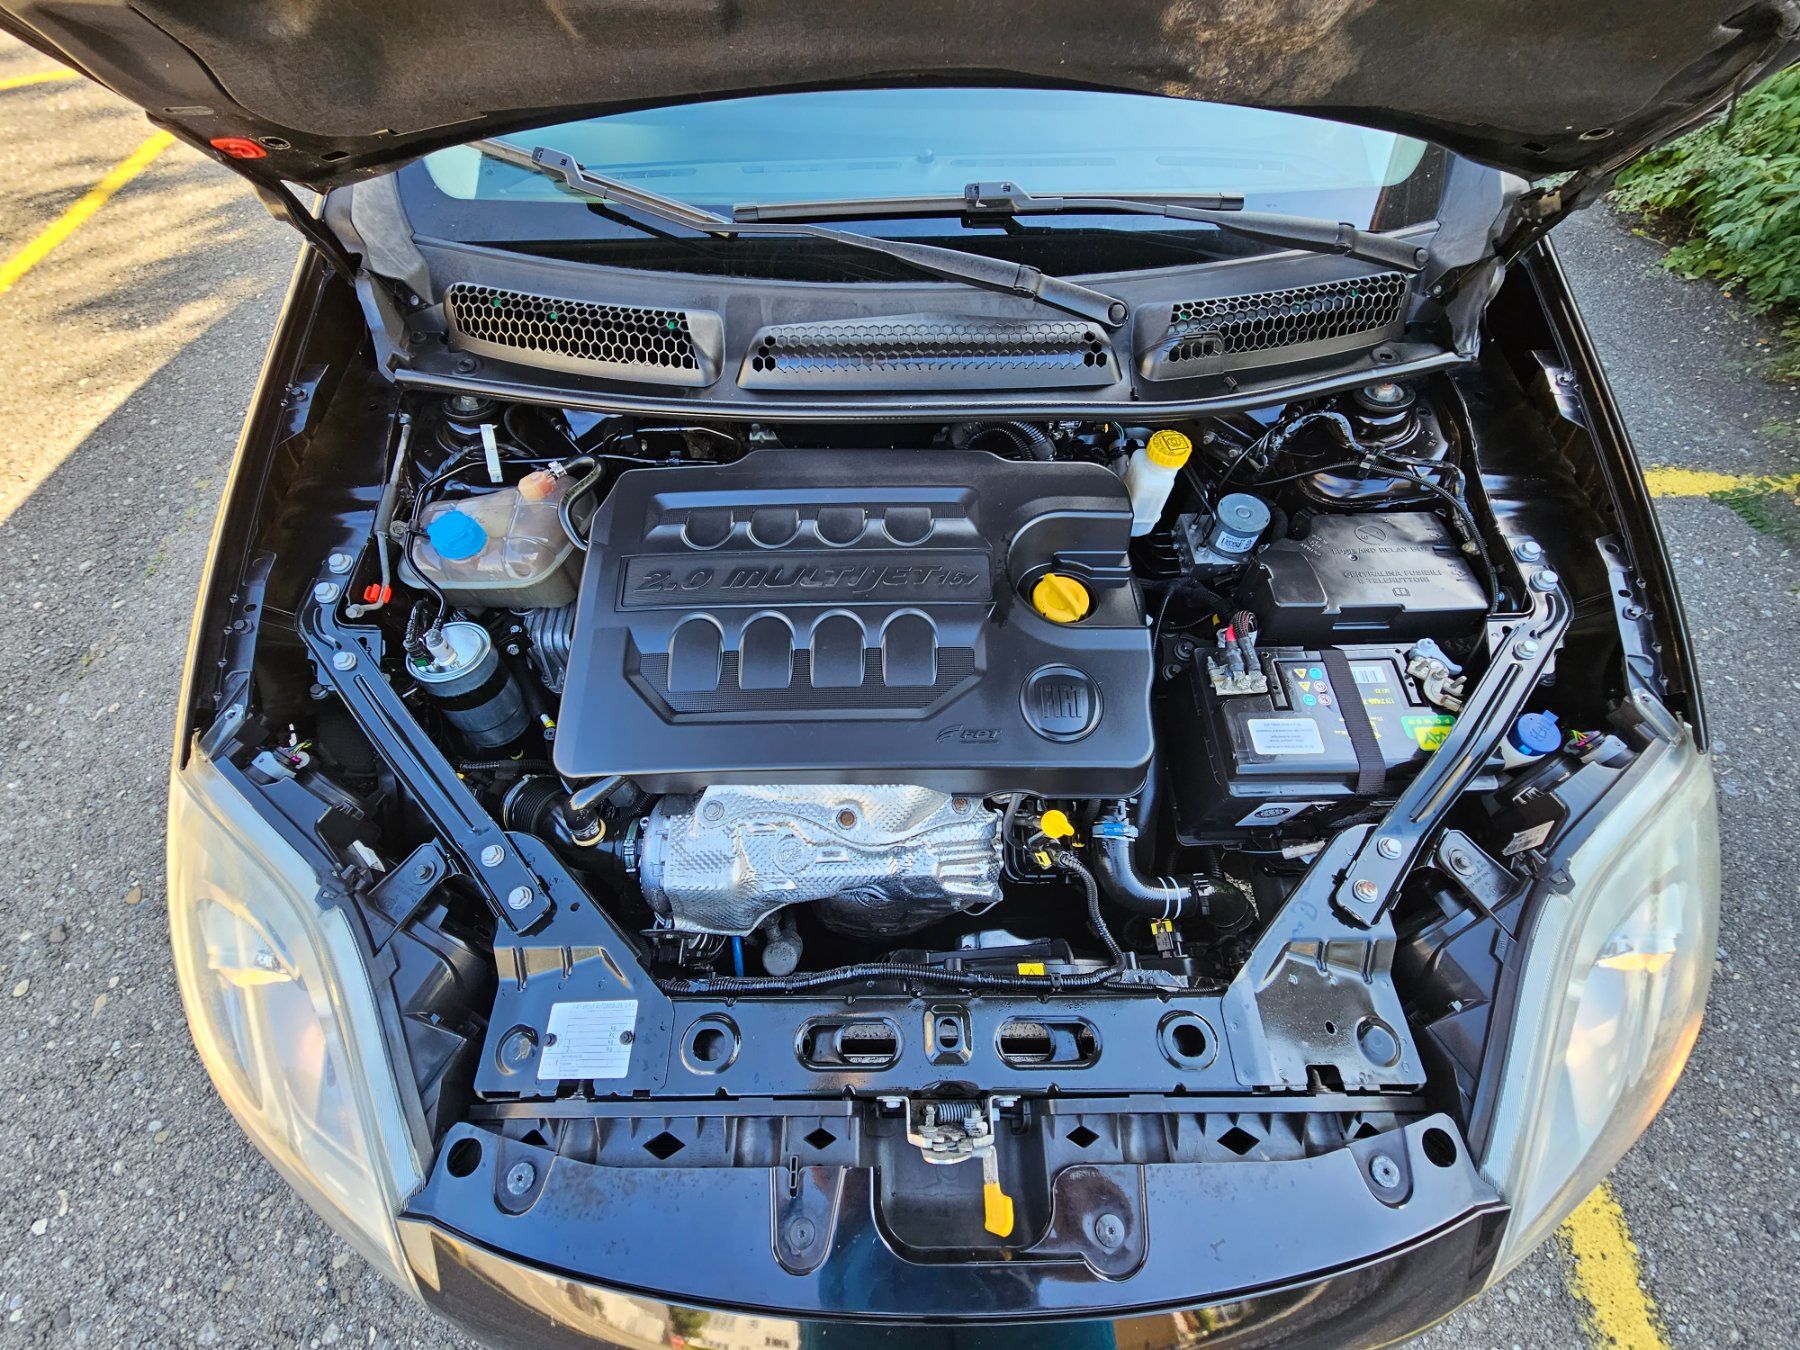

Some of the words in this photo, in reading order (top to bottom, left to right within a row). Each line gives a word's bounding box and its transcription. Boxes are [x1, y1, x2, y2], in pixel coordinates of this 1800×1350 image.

[633, 567, 716, 593] 2.0
[720, 563, 944, 593] MULTIJET
[1040, 683, 1083, 719] FIAT
